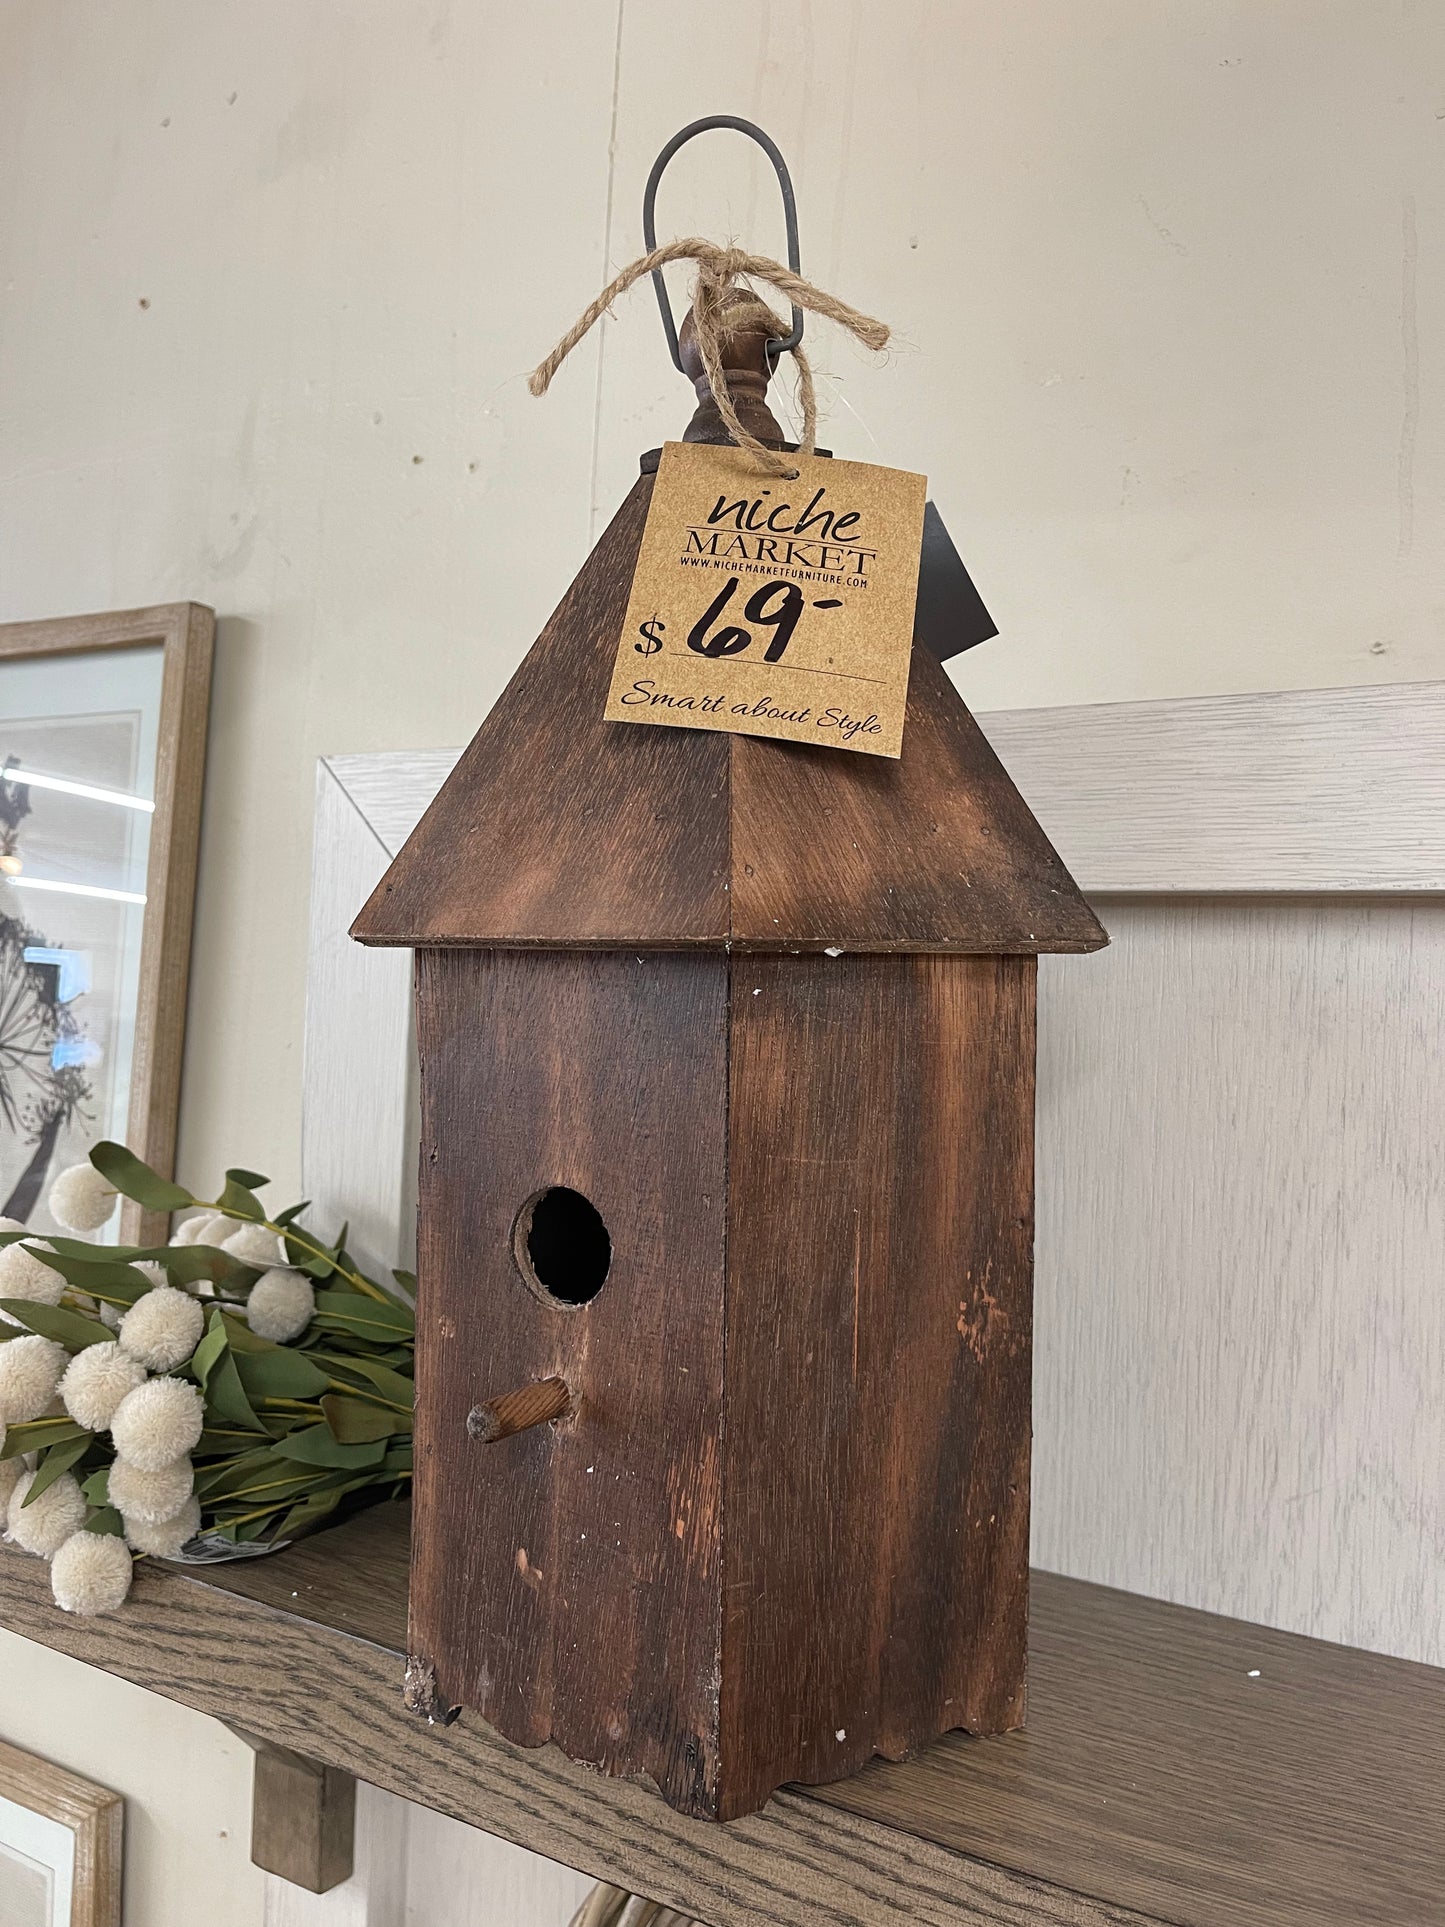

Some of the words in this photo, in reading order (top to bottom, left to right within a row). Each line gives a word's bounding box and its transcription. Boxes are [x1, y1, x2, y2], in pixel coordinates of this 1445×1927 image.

[707, 487, 861, 542] niche
[680, 556, 869, 589] WWW.NICHEMARKETFURNITURE.COM
[685, 530, 877, 576] MARKET
[634, 614, 666, 659] $
[621, 680, 725, 713] Smart
[731, 697, 811, 725] about
[816, 708, 883, 741] Style
